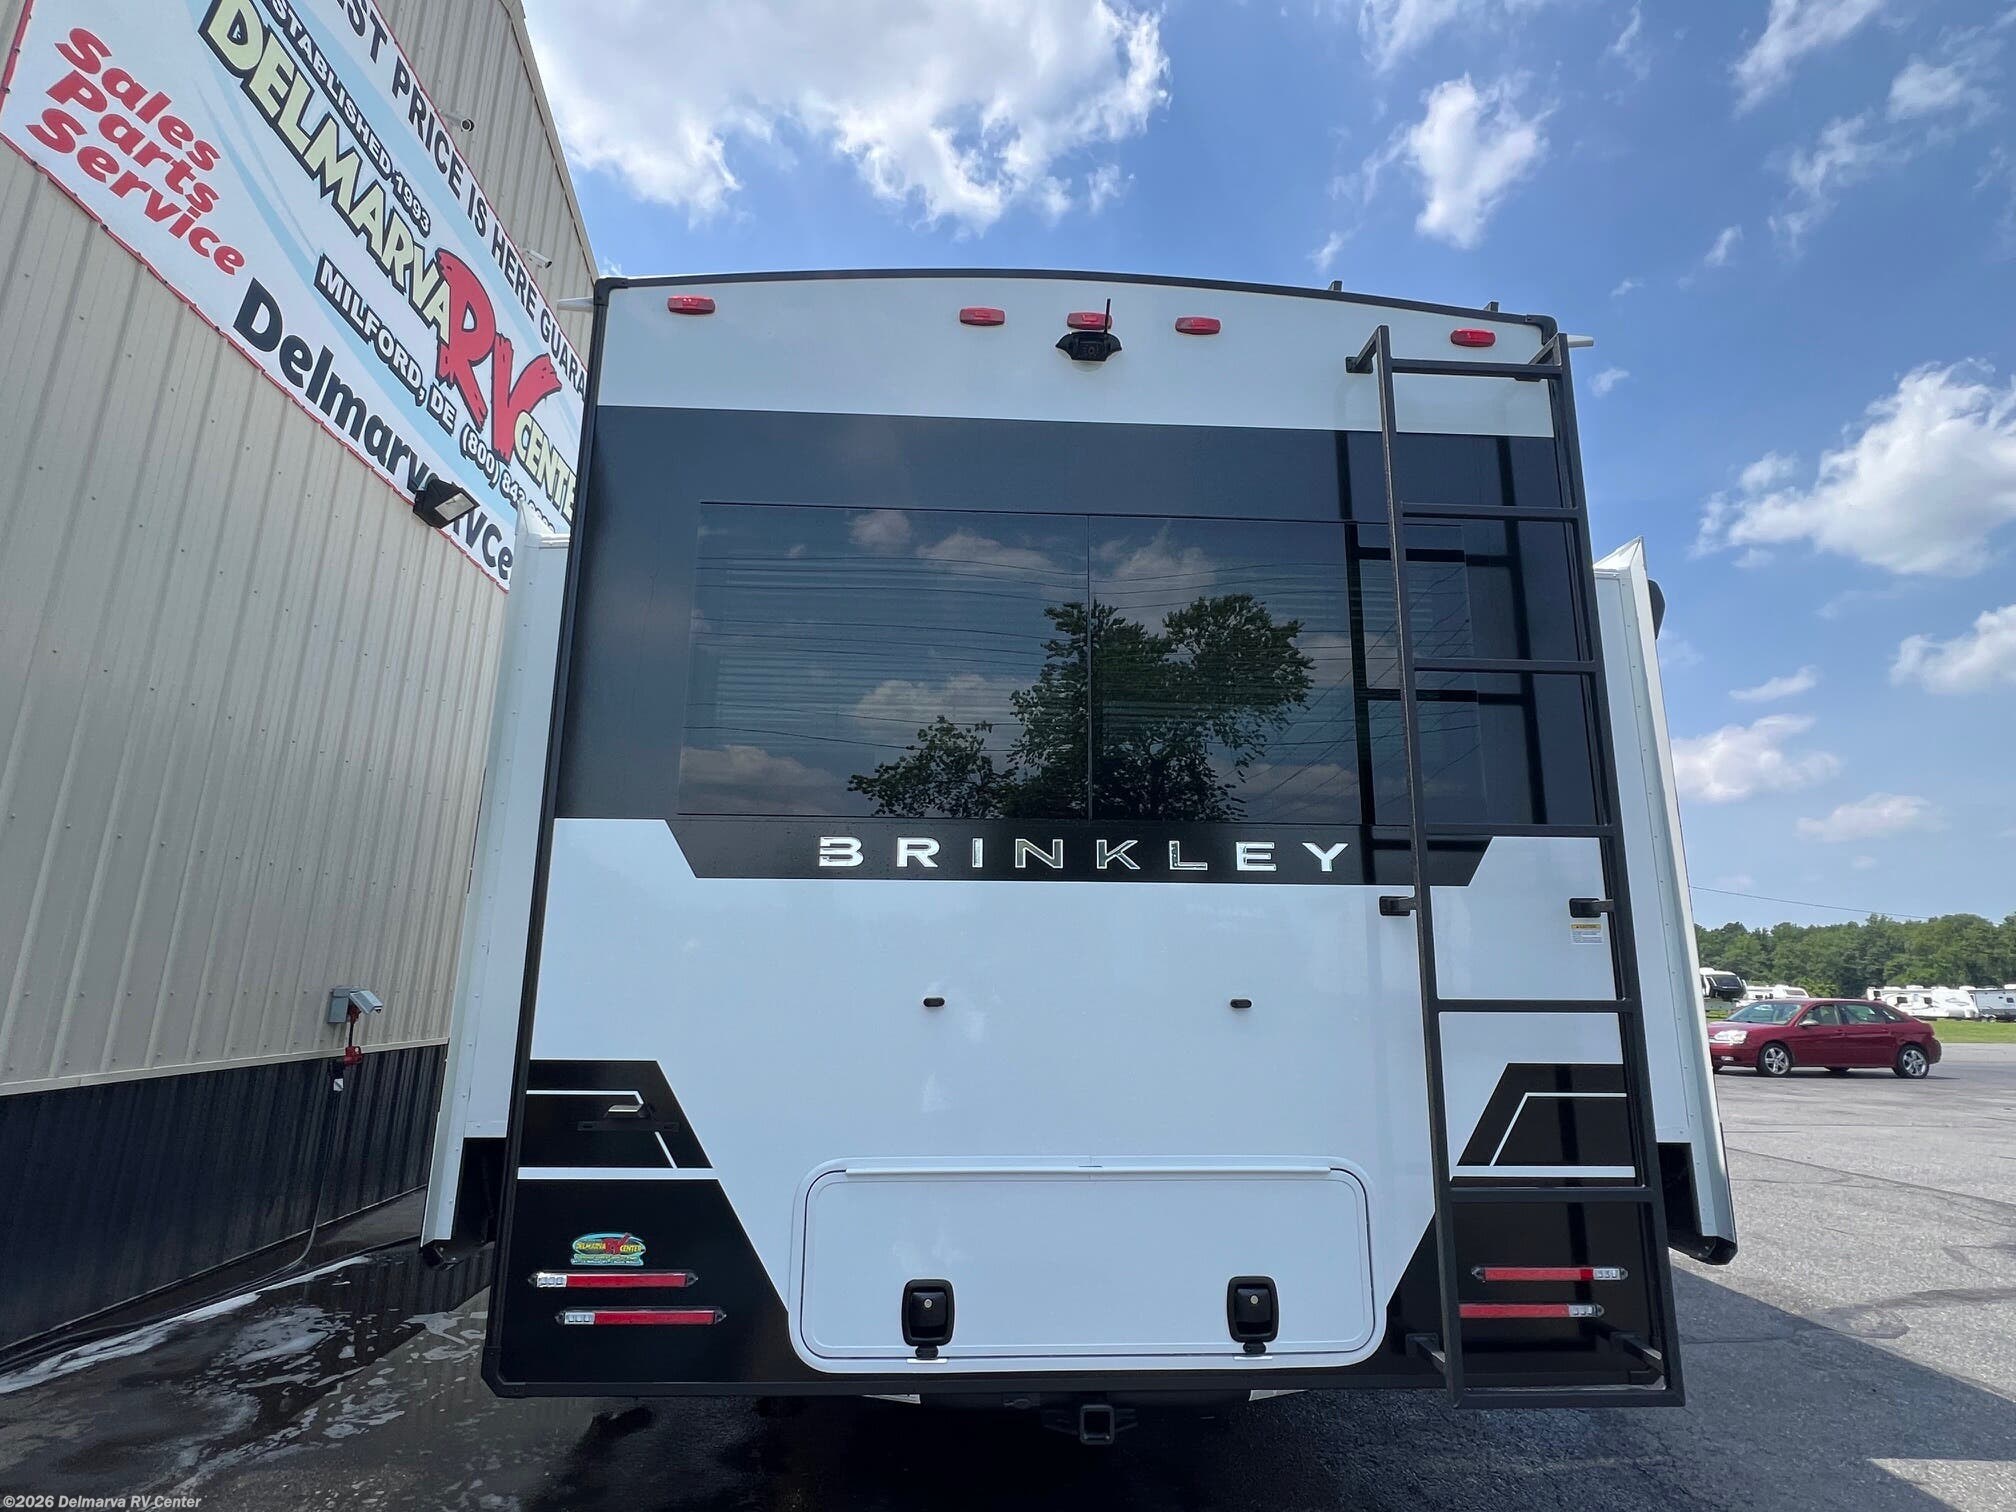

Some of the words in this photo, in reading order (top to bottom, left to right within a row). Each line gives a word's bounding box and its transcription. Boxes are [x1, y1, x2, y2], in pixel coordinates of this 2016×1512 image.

[46, 70, 220, 213] Parts
[54, 28, 221, 171] Sales
[25, 108, 246, 276] Service
[200, 0, 450, 345] DELMARVA
[435, 247, 562, 463] RV
[392, 56, 464, 200] PRICE
[467, 186, 488, 237] IS
[492, 225, 538, 322] HERE
[394, 172, 430, 237] 1993
[315, 254, 426, 406] MILFORD,
[427, 383, 457, 437] DE
[460, 424, 500, 488] (800)
[819, 836, 1349, 872] BRINKLEY
